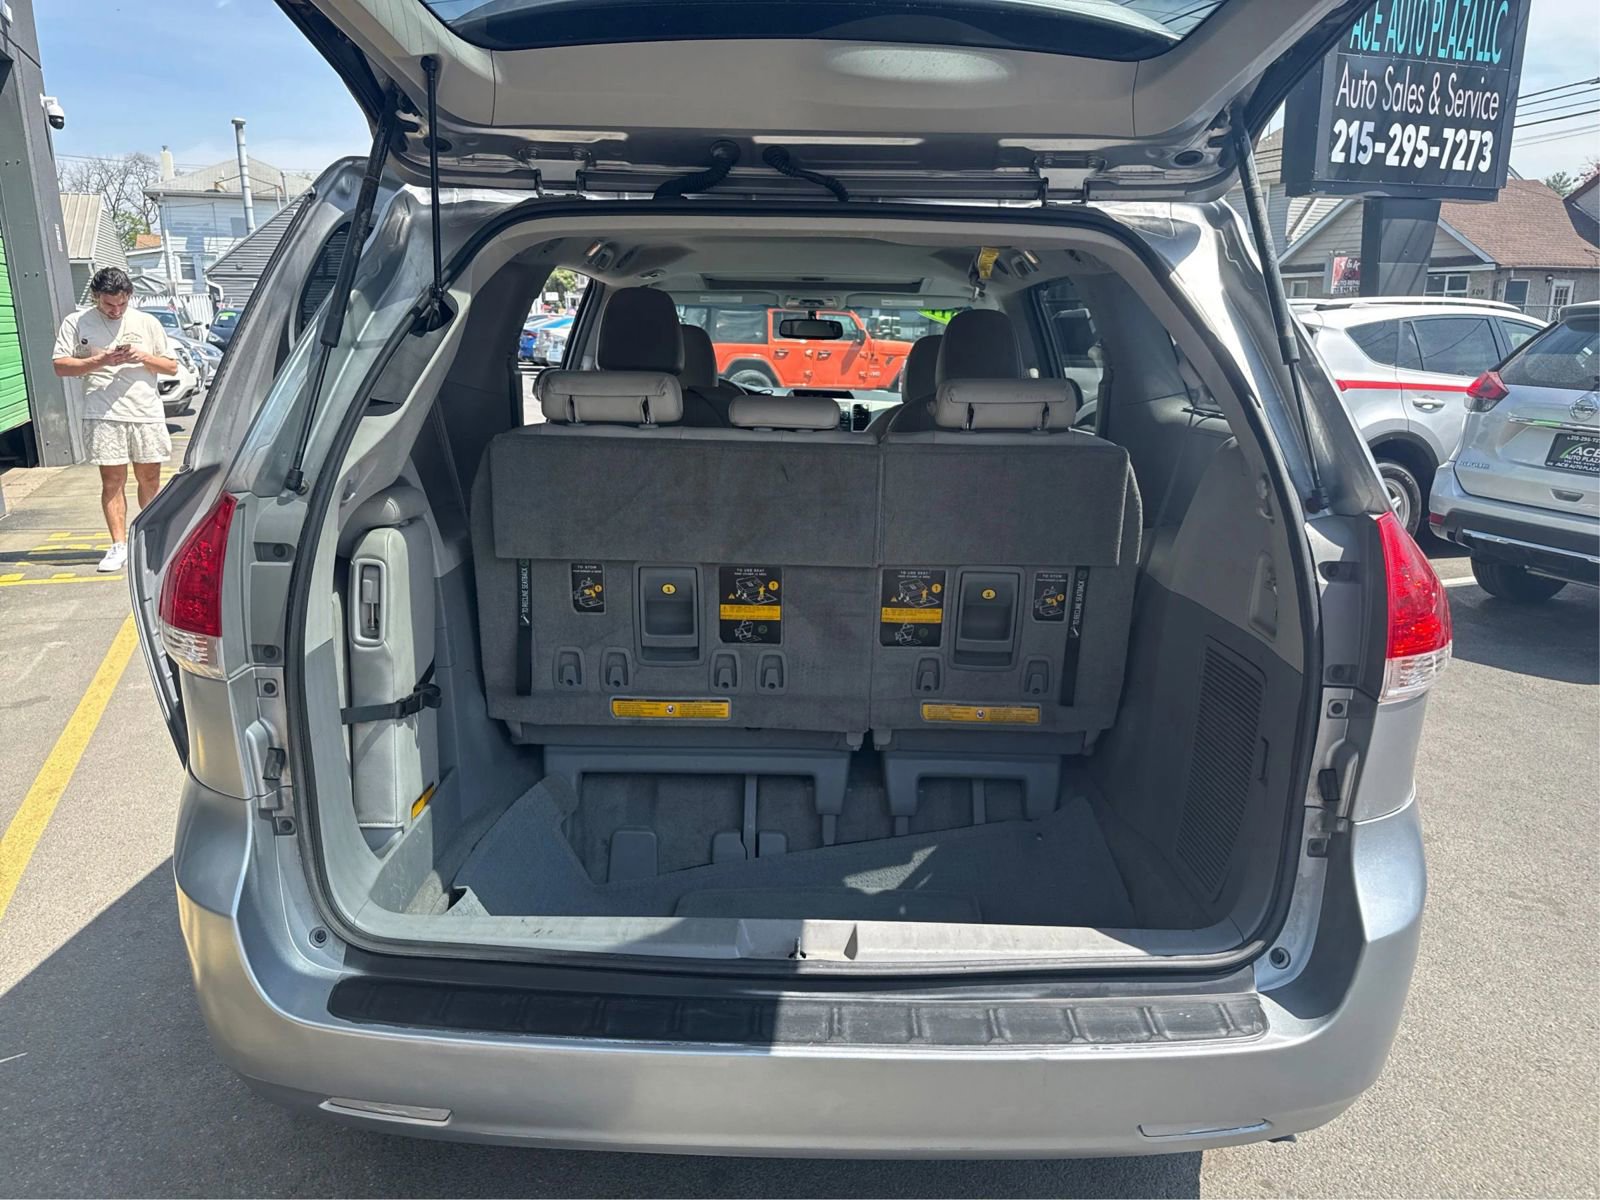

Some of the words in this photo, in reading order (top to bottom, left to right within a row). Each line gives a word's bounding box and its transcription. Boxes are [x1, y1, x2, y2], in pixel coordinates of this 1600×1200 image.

[1429, 0, 1477, 60] PLAZA
[1336, 61, 1377, 110] Auto
[1382, 65, 1425, 113] Sales
[1428, 71, 1441, 115] &
[1445, 72, 1499, 121] Service
[1330, 118, 1494, 173] 215-295-7273
[1570, 446, 1600, 458] ACE
